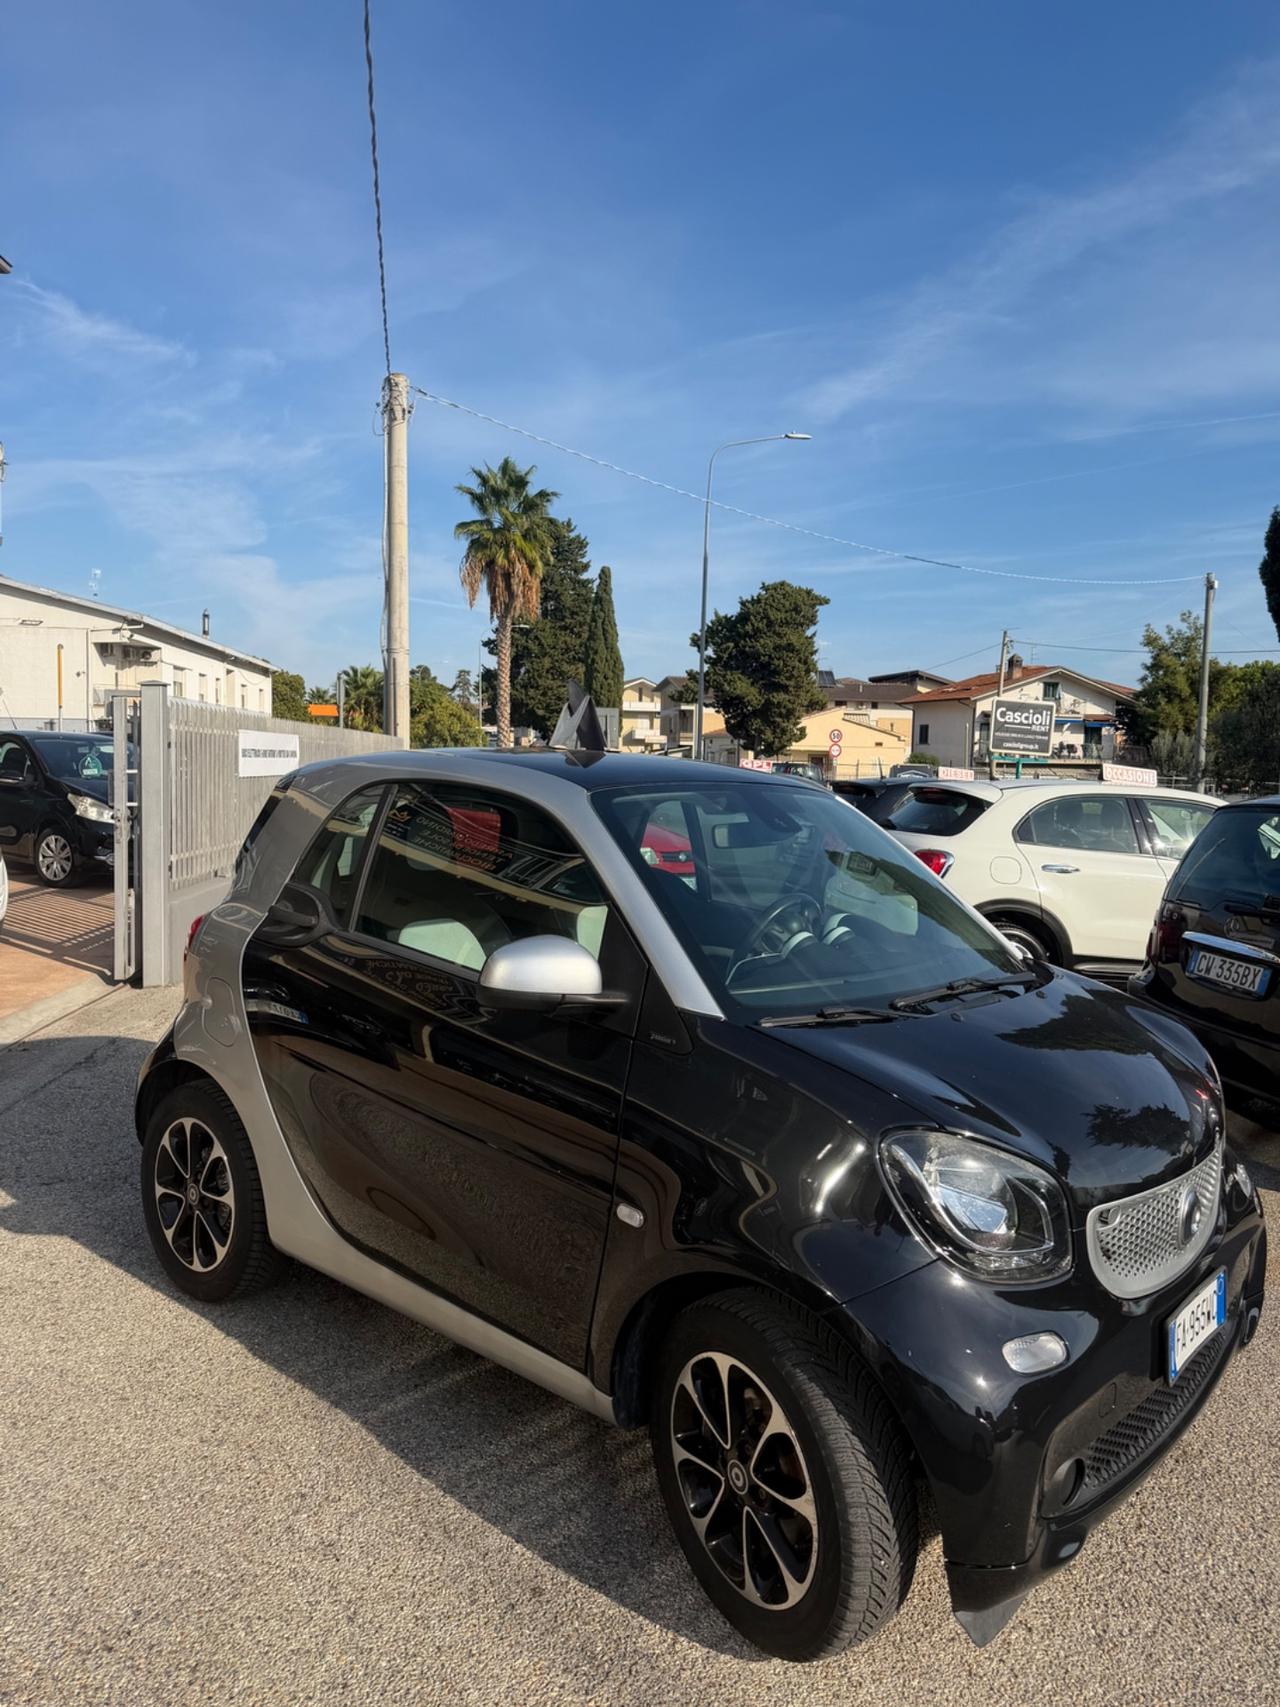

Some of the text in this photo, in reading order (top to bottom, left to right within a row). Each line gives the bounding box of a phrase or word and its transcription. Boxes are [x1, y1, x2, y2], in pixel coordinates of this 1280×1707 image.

[996, 707, 1051, 725] Cascioli
[742, 759, 772, 769] GPL
[1196, 954, 1261, 990] CW 335BX
